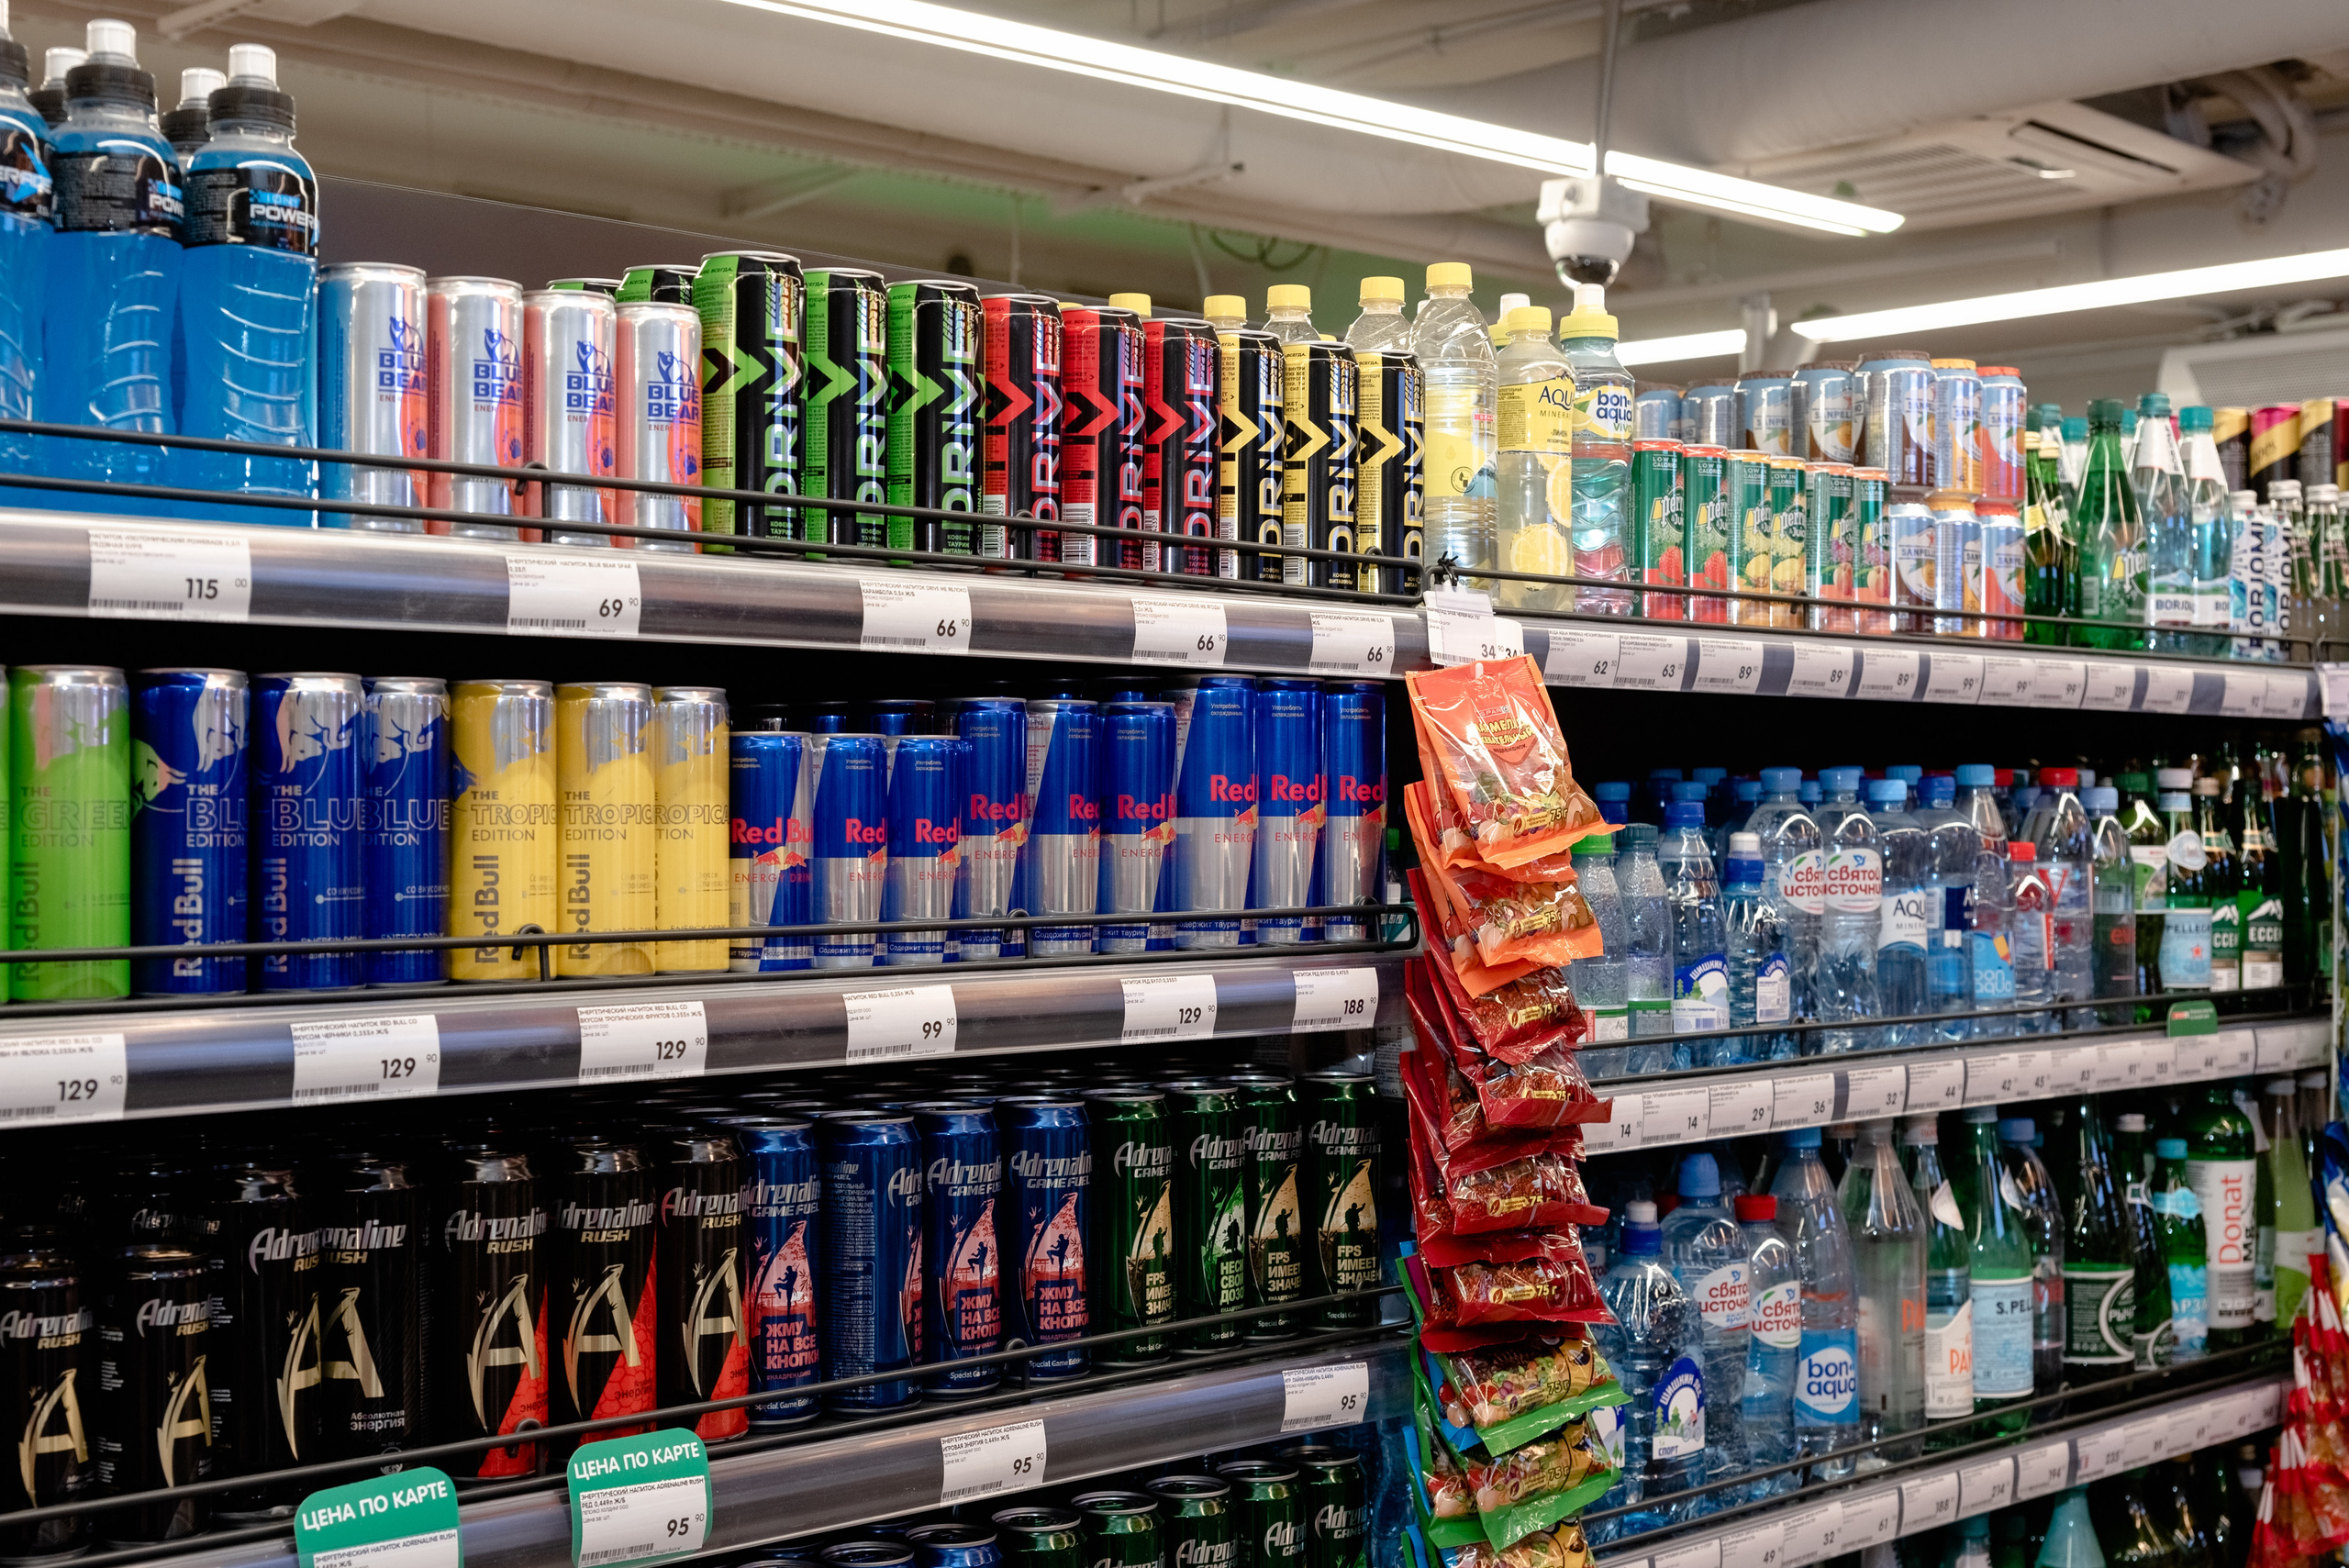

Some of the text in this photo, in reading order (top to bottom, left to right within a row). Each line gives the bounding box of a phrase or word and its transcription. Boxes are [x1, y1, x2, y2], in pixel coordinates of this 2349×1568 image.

[567, 374, 615, 393] BLUE
[648, 384, 699, 401] BLUE
[567, 393, 615, 411] BEAR
[648, 403, 699, 420] BEAR
[1597, 406, 1632, 427] aqua
[186, 578, 247, 599] 115 00
[599, 599, 622, 617] 69
[937, 619, 956, 637] 66
[1197, 635, 1214, 651] 66
[1367, 647, 1382, 662] 66
[1481, 644, 1496, 659] 34
[1594, 661, 1608, 674] 62
[1663, 664, 1675, 677] 63
[1739, 666, 1752, 679] 89
[1831, 670, 1842, 683] 89
[1898, 673, 1909, 685] 89
[1963, 678, 1974, 690] 99
[2017, 681, 2028, 693] 99
[21, 786, 50, 797] THE
[187, 784, 218, 795] THE
[1210, 774, 1254, 801] Red
[1271, 774, 1319, 801] Red
[1340, 775, 1384, 801] Red
[471, 791, 498, 800] THE
[564, 791, 590, 800] THE
[971, 795, 1018, 819] Red
[1118, 795, 1164, 819] Red
[1551, 809, 1562, 820] 75
[472, 829, 535, 841] EDITION
[565, 829, 627, 840] EDITION
[732, 818, 782, 843] Red
[916, 818, 956, 843] Red
[21, 834, 94, 847] EDITION
[186, 833, 244, 847] EDITION
[889, 943, 920, 952] Содержит
[1343, 999, 1364, 1015] 188
[1179, 1007, 1201, 1024] 129
[923, 1018, 954, 1040] 99 90
[656, 1038, 705, 1060] 129 90
[381, 1053, 437, 1079] 129 90
[59, 1075, 123, 1101] 129 90
[1945, 1087, 1955, 1098] 44
[2002, 1080, 2011, 1091] 42
[1886, 1093, 1898, 1105] 32
[1753, 1109, 1764, 1121] 29
[1814, 1102, 1825, 1114] 36
[1687, 1118, 1697, 1129] 14
[1620, 1125, 1631, 1138] 14
[1256, 1149, 1286, 1162] GAME
[1027, 1176, 1090, 1189] GAME FUEL
[751, 1202, 819, 1218] GAME FUEL
[701, 1215, 741, 1229] RUSH
[2219, 1174, 2243, 1264] Donat
[581, 1229, 630, 1243] RUSH
[487, 1239, 533, 1254] RUSH
[1338, 1257, 1376, 1271] ИМЕЕТ
[1040, 1286, 1074, 1301] ЖМУ
[1537, 1285, 1549, 1296] 75
[1040, 1300, 1085, 1316] НА ВСЕ
[766, 1321, 803, 1336] ЖМУ
[38, 1332, 81, 1350] RUSH
[766, 1336, 816, 1352] НА ВСЕ
[766, 1351, 819, 1370] КНОПКИ
[1548, 1381, 1561, 1396] 75
[1807, 1377, 1855, 1399] aqua
[1341, 1396, 1356, 1410] 95
[351, 1409, 405, 1421] Абсолютная
[350, 1418, 405, 1432] энергия
[1658, 1446, 1679, 1456] СПОРТ
[574, 1442, 700, 1481] ЦЕНА ПО КАРТЕ
[1013, 1452, 1044, 1475] 95 90
[629, 1485, 655, 1493] НАПИТОК
[656, 1480, 688, 1490] ADRENALINE
[689, 1477, 704, 1485] RUSH
[303, 1481, 448, 1532] ЦЕНА ПО КАРТЕ
[667, 1513, 705, 1538] 95 90
[1879, 1519, 1888, 1531] 61
[1824, 1531, 1835, 1544] 32
[1764, 1550, 1776, 1562] 49
